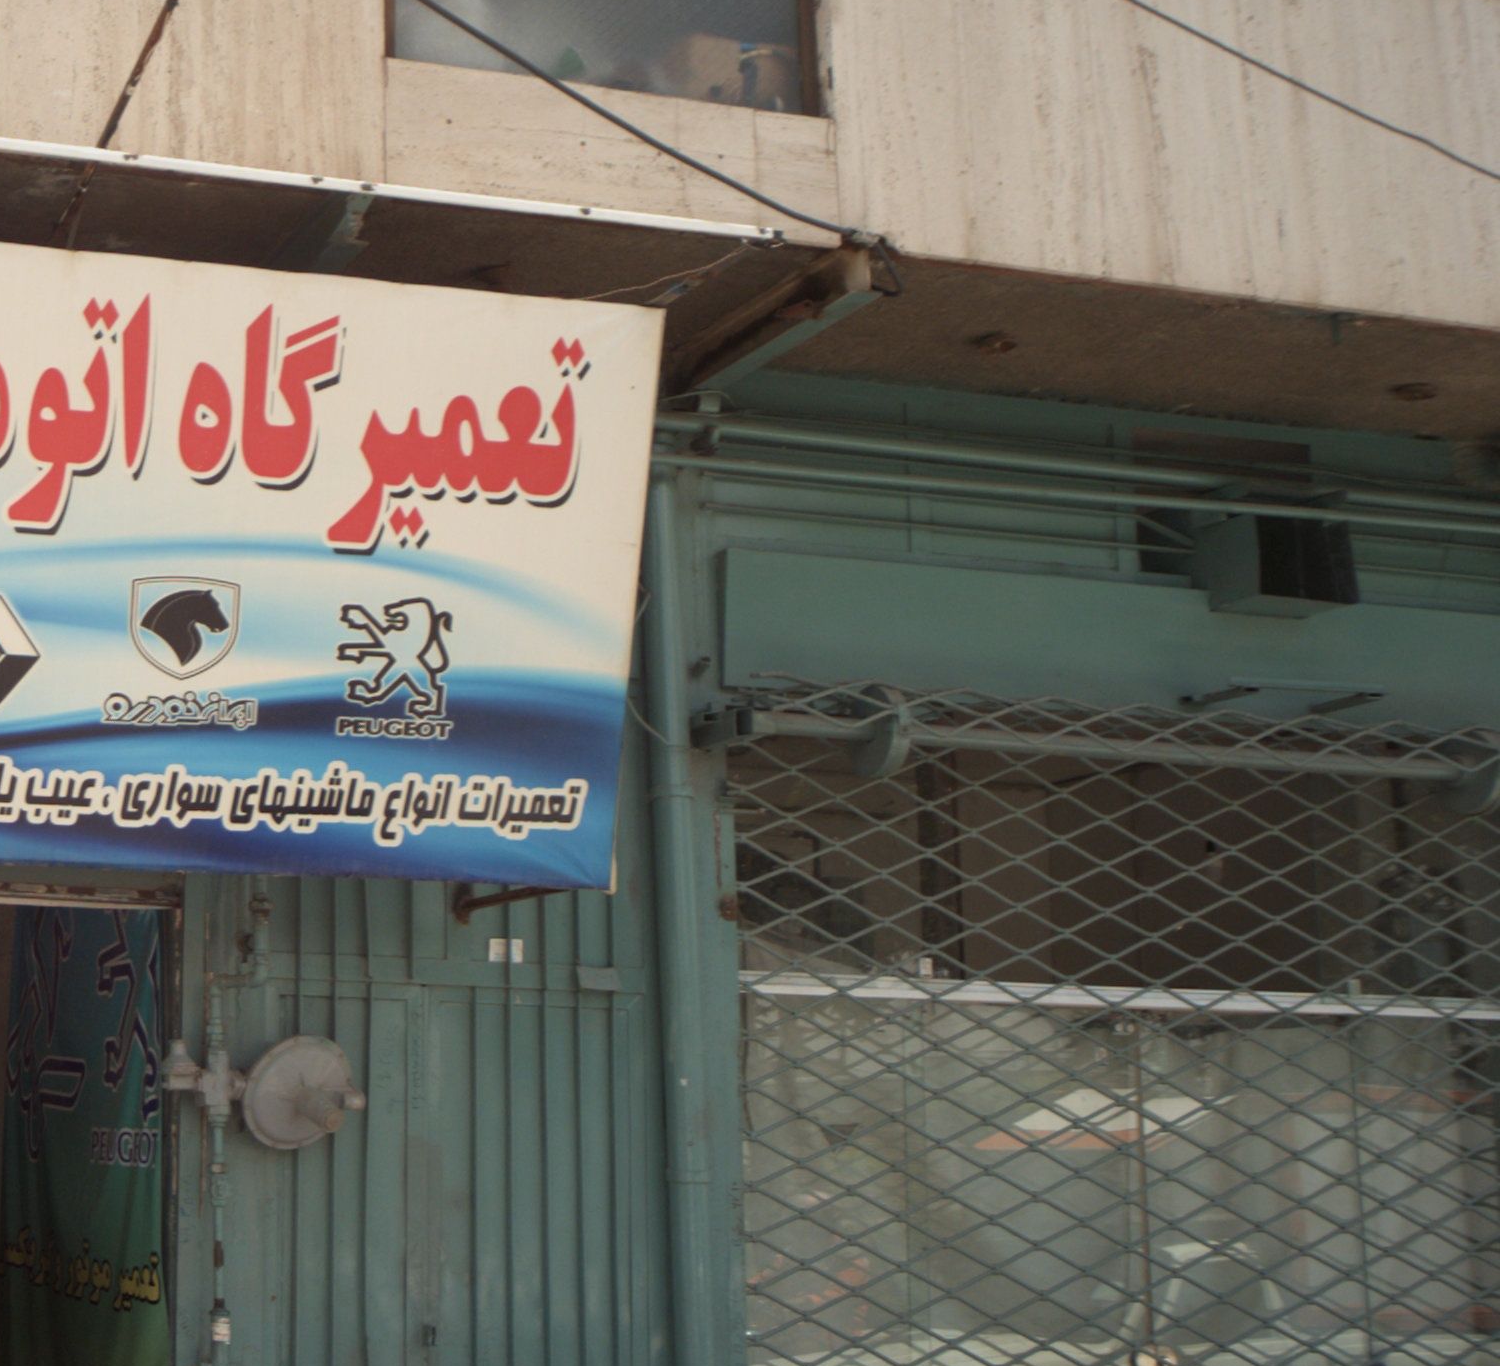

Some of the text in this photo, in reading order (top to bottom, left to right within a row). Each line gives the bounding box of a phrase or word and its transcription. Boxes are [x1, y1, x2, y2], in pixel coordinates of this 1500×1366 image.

[338, 717, 451, 740] PEUGEOT
[25, 772, 97, 819] عیب
[230, 767, 375, 828] ماشینهای
[381, 777, 454, 841] انواع
[457, 780, 582, 834] تعمیرات
[64, 1237, 112, 1305] موتور
[113, 1250, 161, 1312] تعمیر
